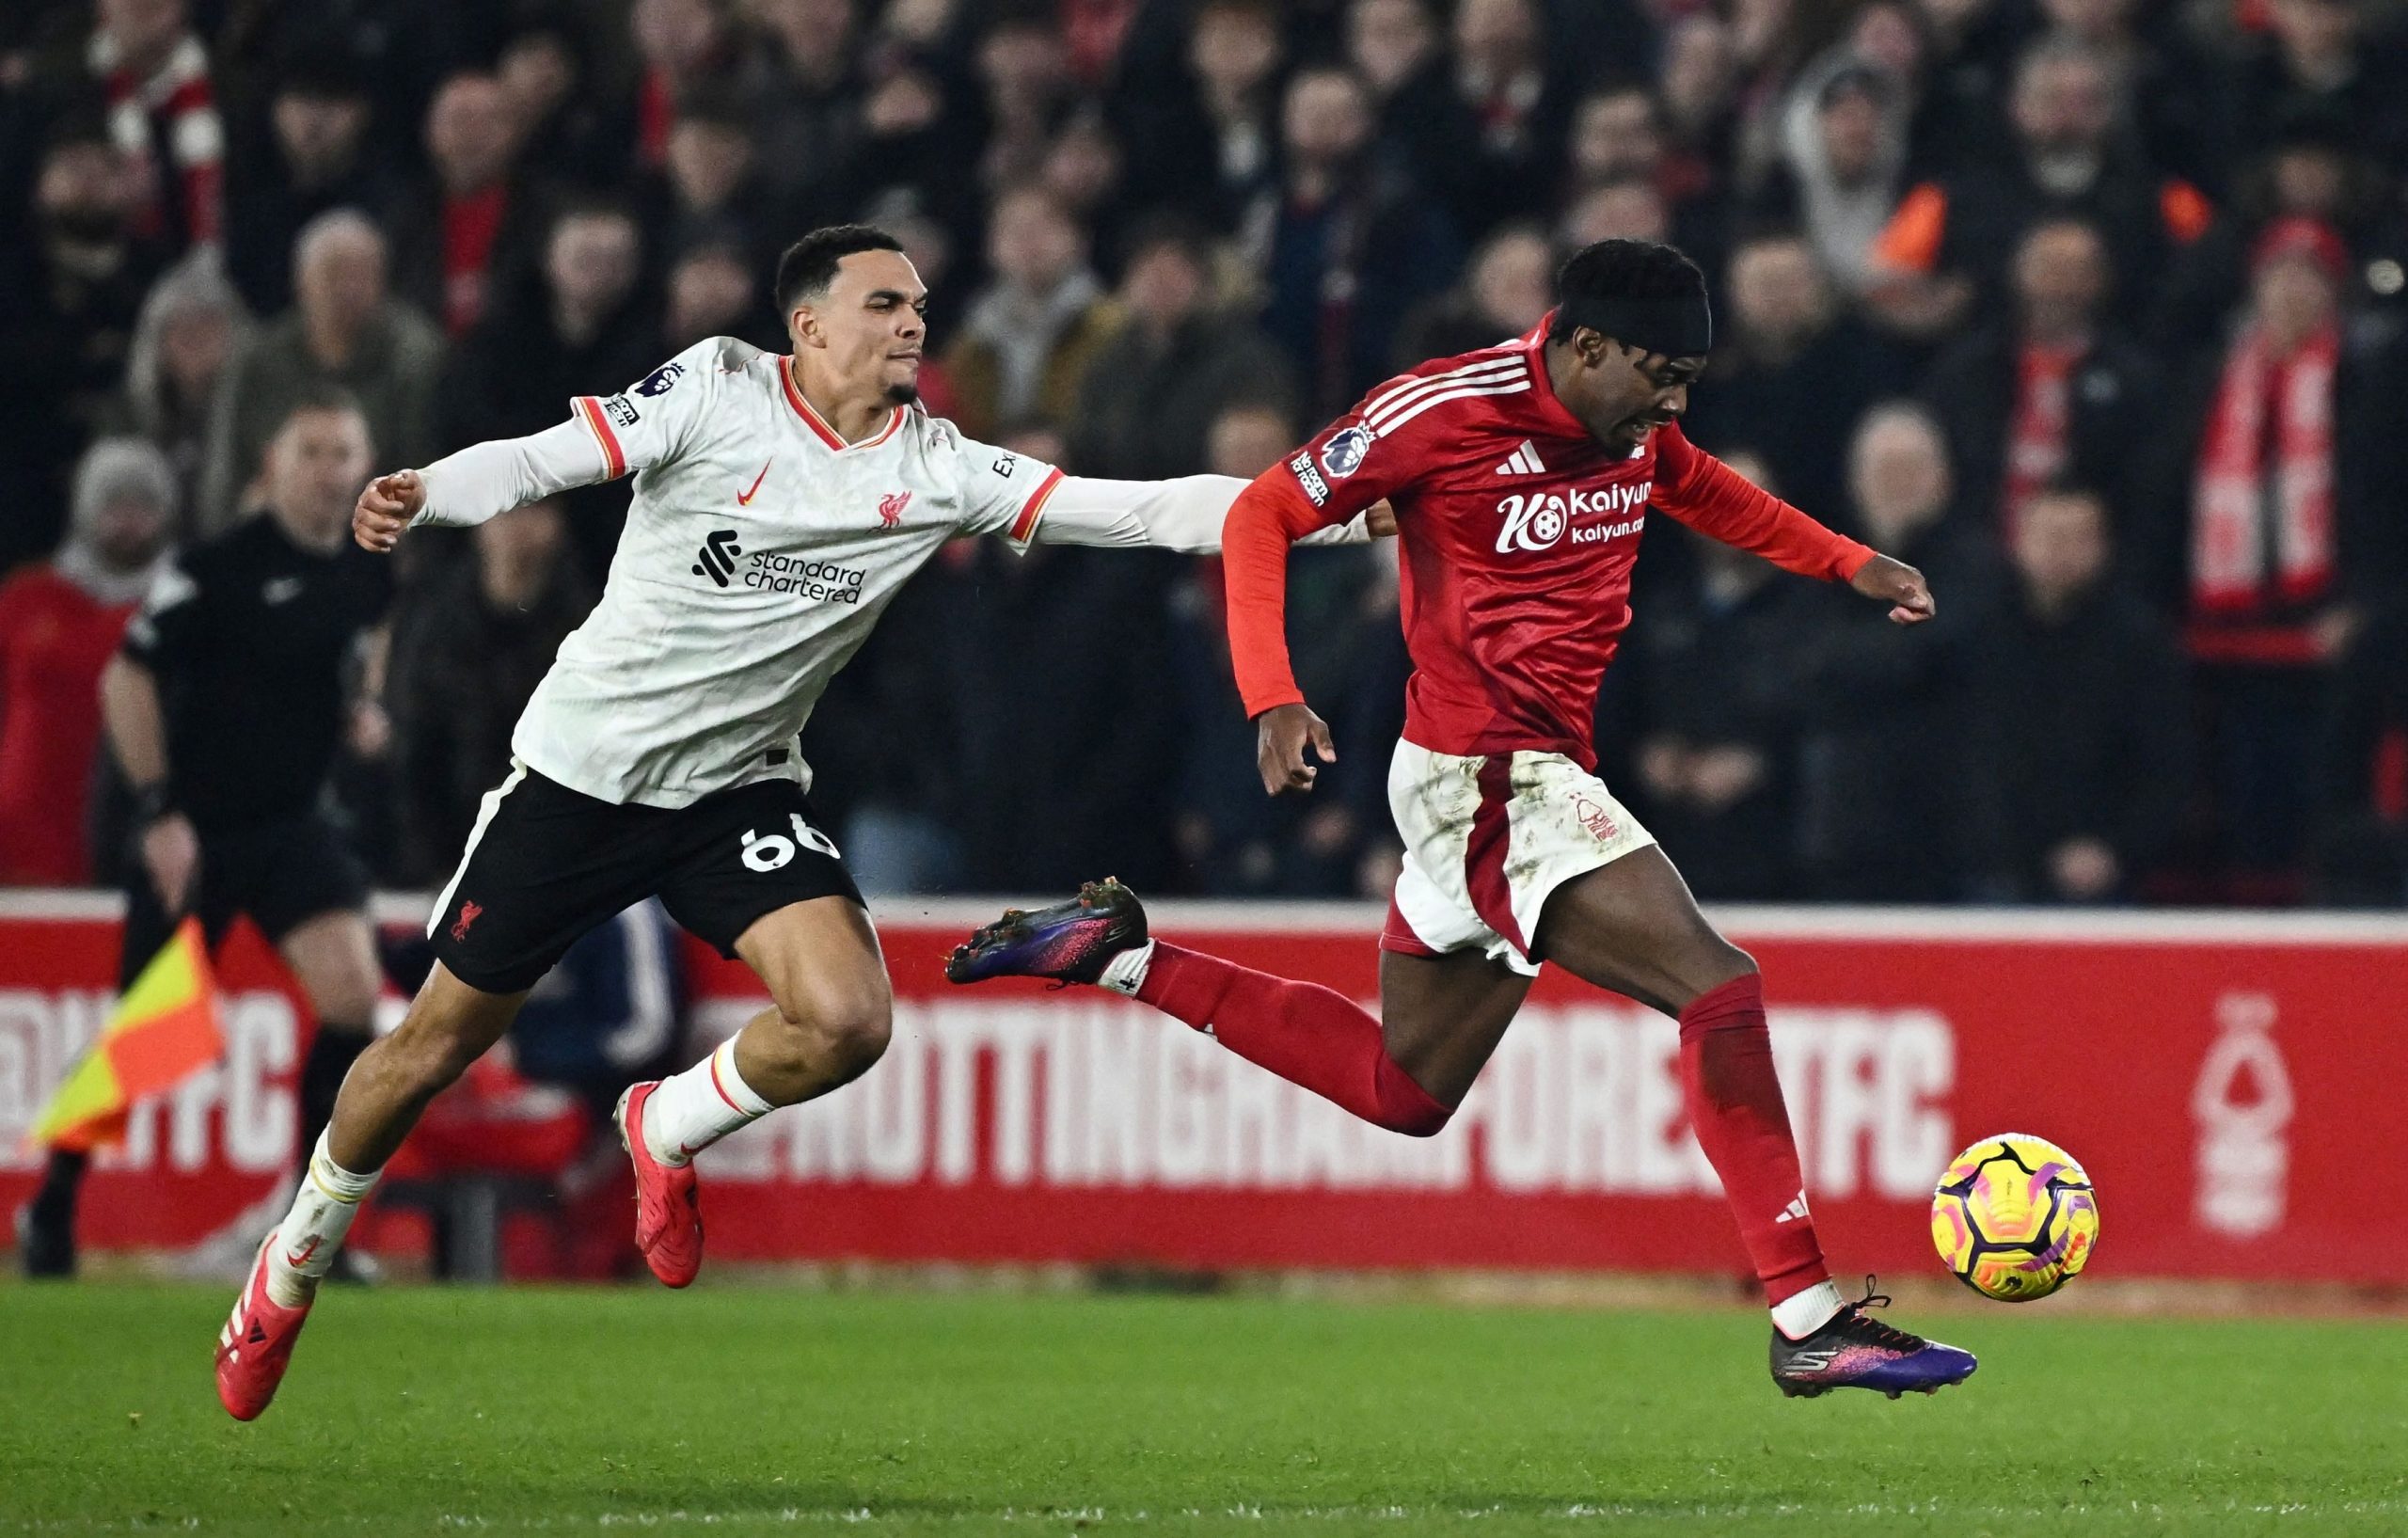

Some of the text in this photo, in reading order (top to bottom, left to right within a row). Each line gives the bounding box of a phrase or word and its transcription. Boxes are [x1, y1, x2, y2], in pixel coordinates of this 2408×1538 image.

[992, 452, 1016, 479] Ex
[1299, 451, 1329, 498] No room
[1298, 470, 1325, 507] racism
[1570, 482, 1652, 515] kaiyun
[751, 549, 866, 587] standard
[744, 570, 862, 605] chartered
[740, 813, 841, 873] 66
